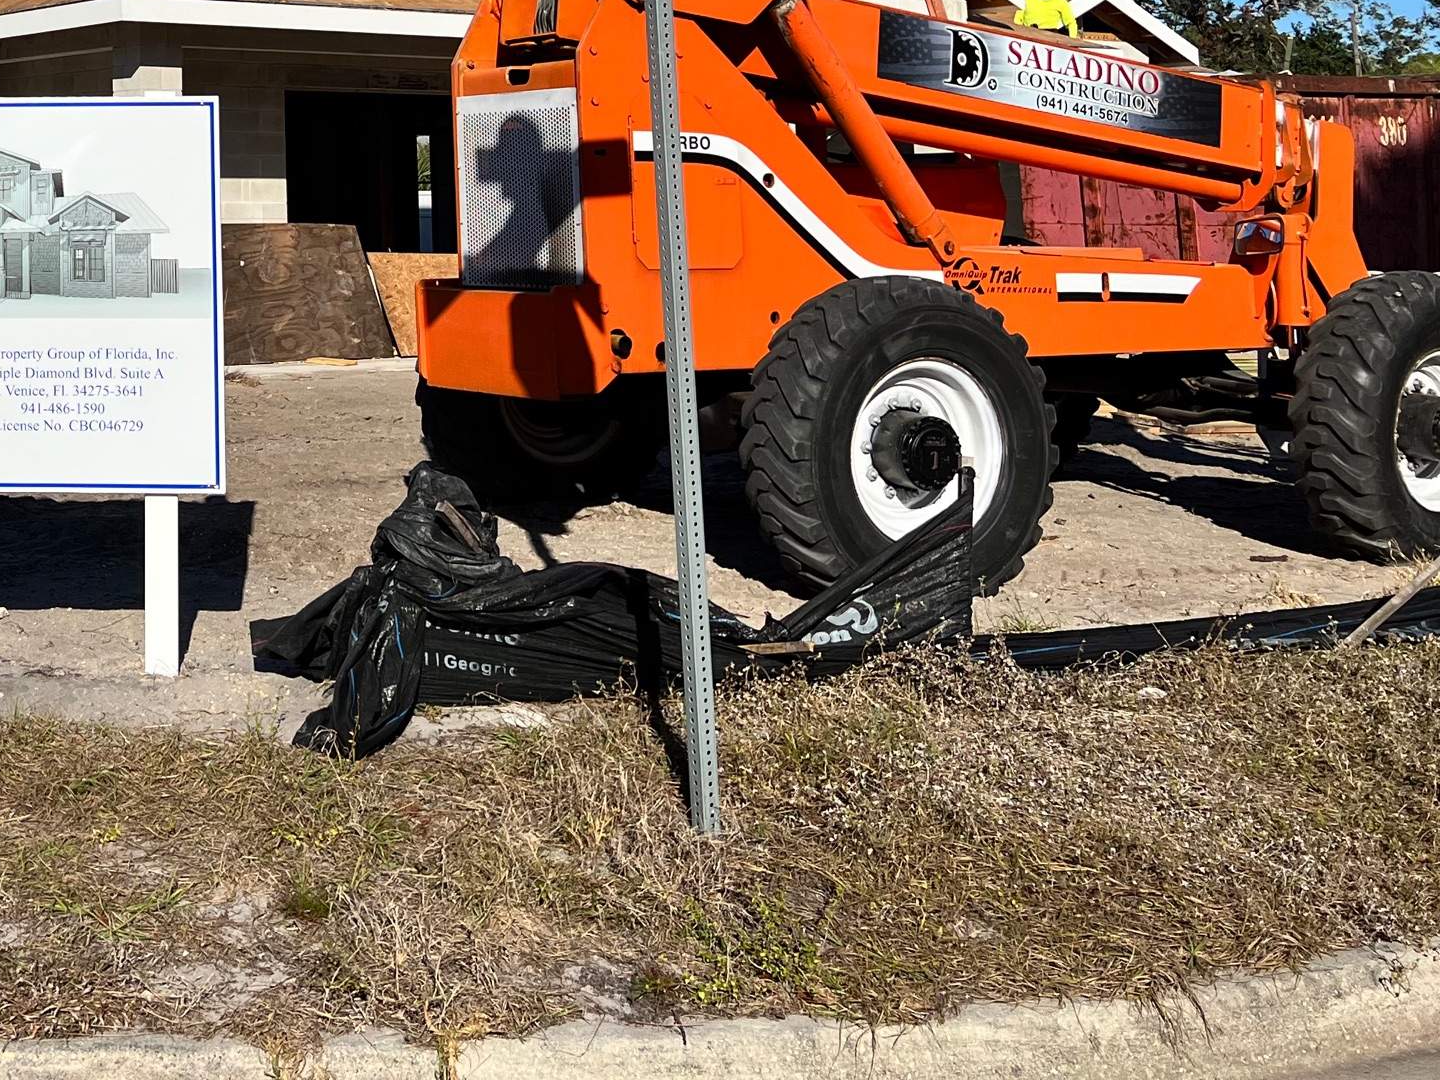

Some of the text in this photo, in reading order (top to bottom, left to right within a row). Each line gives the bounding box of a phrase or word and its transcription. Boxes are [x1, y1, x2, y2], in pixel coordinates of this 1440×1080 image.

[1007, 40, 1160, 95] SALADINO
[1017, 71, 1160, 116] CONSTRUCTION
[1036, 94, 1129, 124] (941) 441-5674
[944, 270, 988, 280] OmniQuip
[989, 266, 1022, 284] Trak
[986, 286, 1052, 294] INTERNATIONAL
[47, 347, 86, 363] Group
[89, 347, 103, 360] of
[105, 347, 152, 362] Florida,
[155, 347, 179, 360] Inc.
[25, 366, 81, 379] Diamond
[84, 366, 116, 379] Blvd.
[120, 366, 152, 379] Suite
[154, 367, 165, 379] A
[6, 385, 49, 398] Venice,
[53, 385, 66, 397] Fl.
[72, 385, 144, 397] 34275-3641
[20, 402, 106, 415] 941-486-1590
[43, 419, 65, 432] No.
[68, 419, 144, 432] CBC046729
